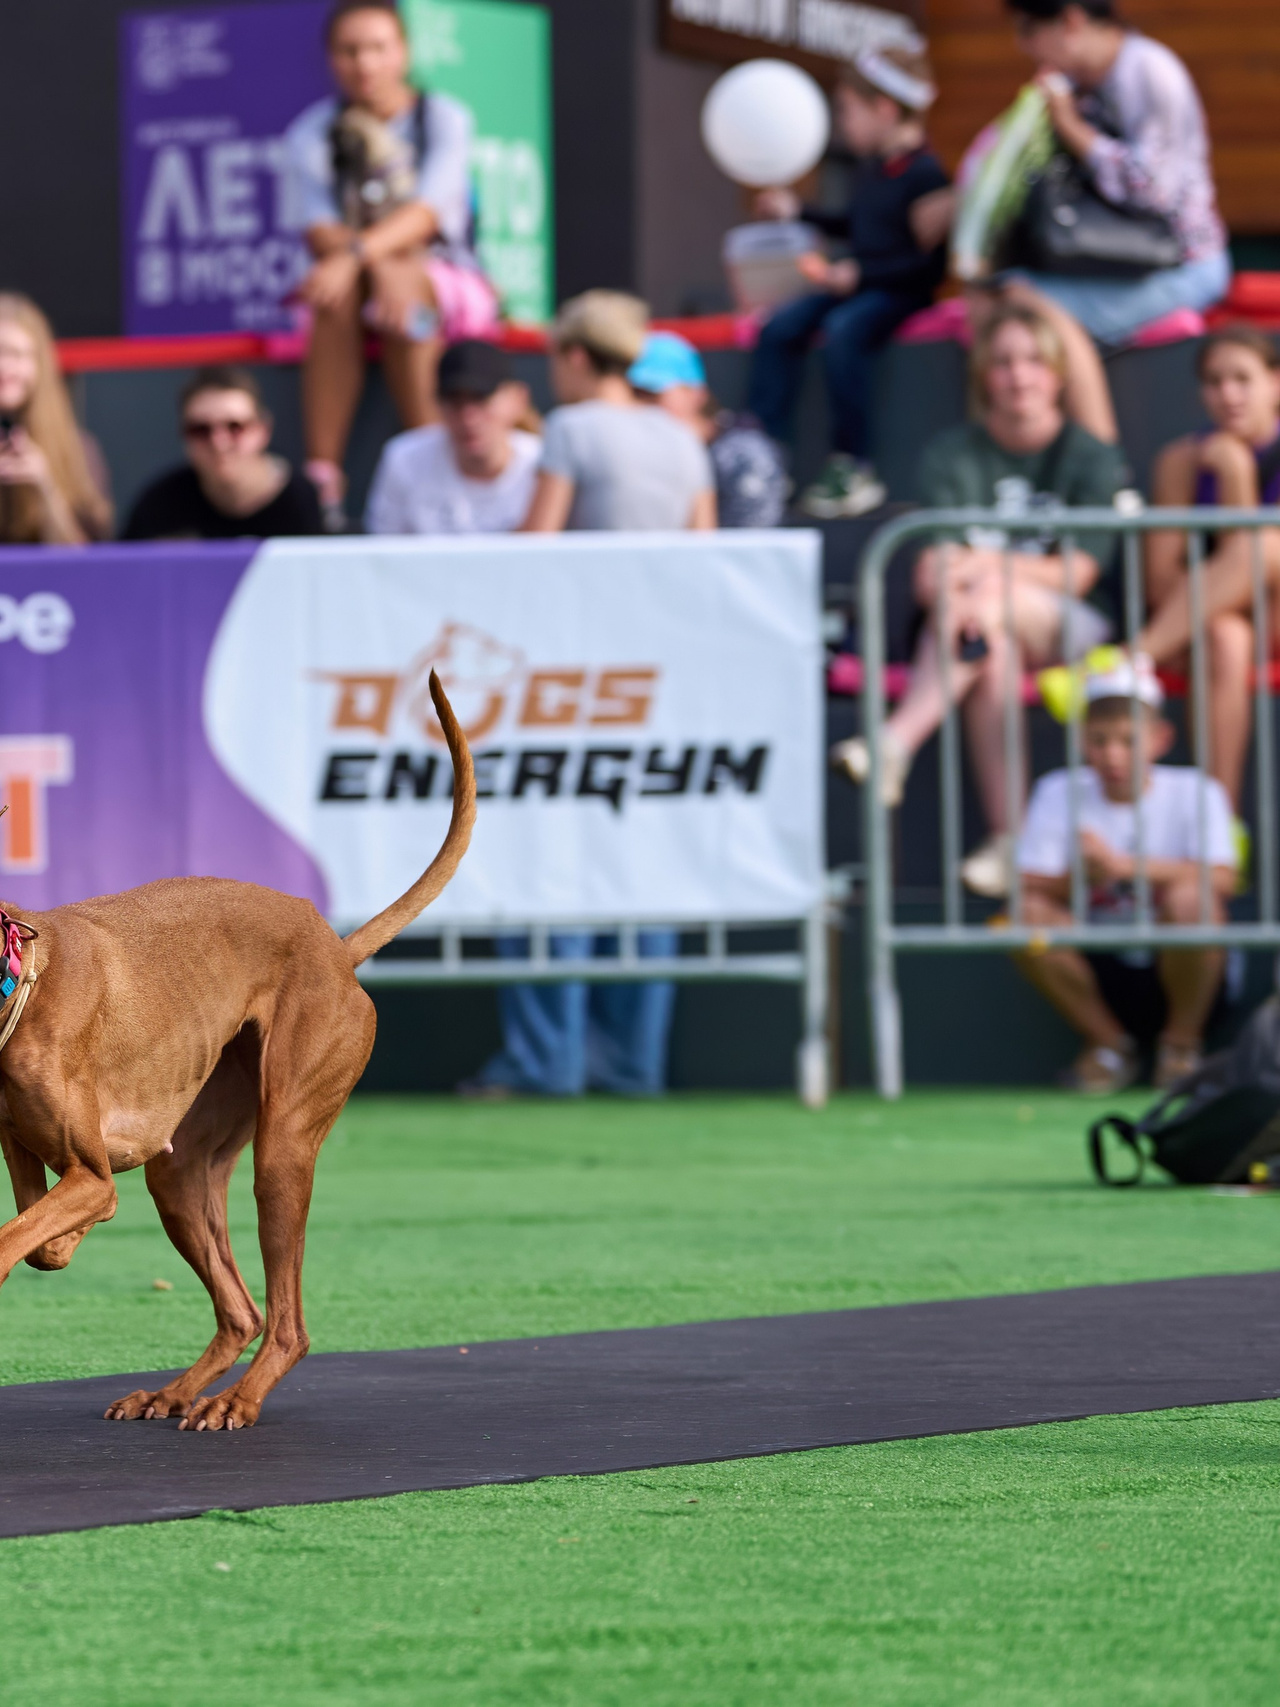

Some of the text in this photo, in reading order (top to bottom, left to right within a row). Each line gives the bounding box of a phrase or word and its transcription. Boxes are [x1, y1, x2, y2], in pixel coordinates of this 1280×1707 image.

[137, 142, 310, 238] ЛЕТ
[310, 663, 660, 746] DOGS
[319, 742, 772, 818] ENERGYM
